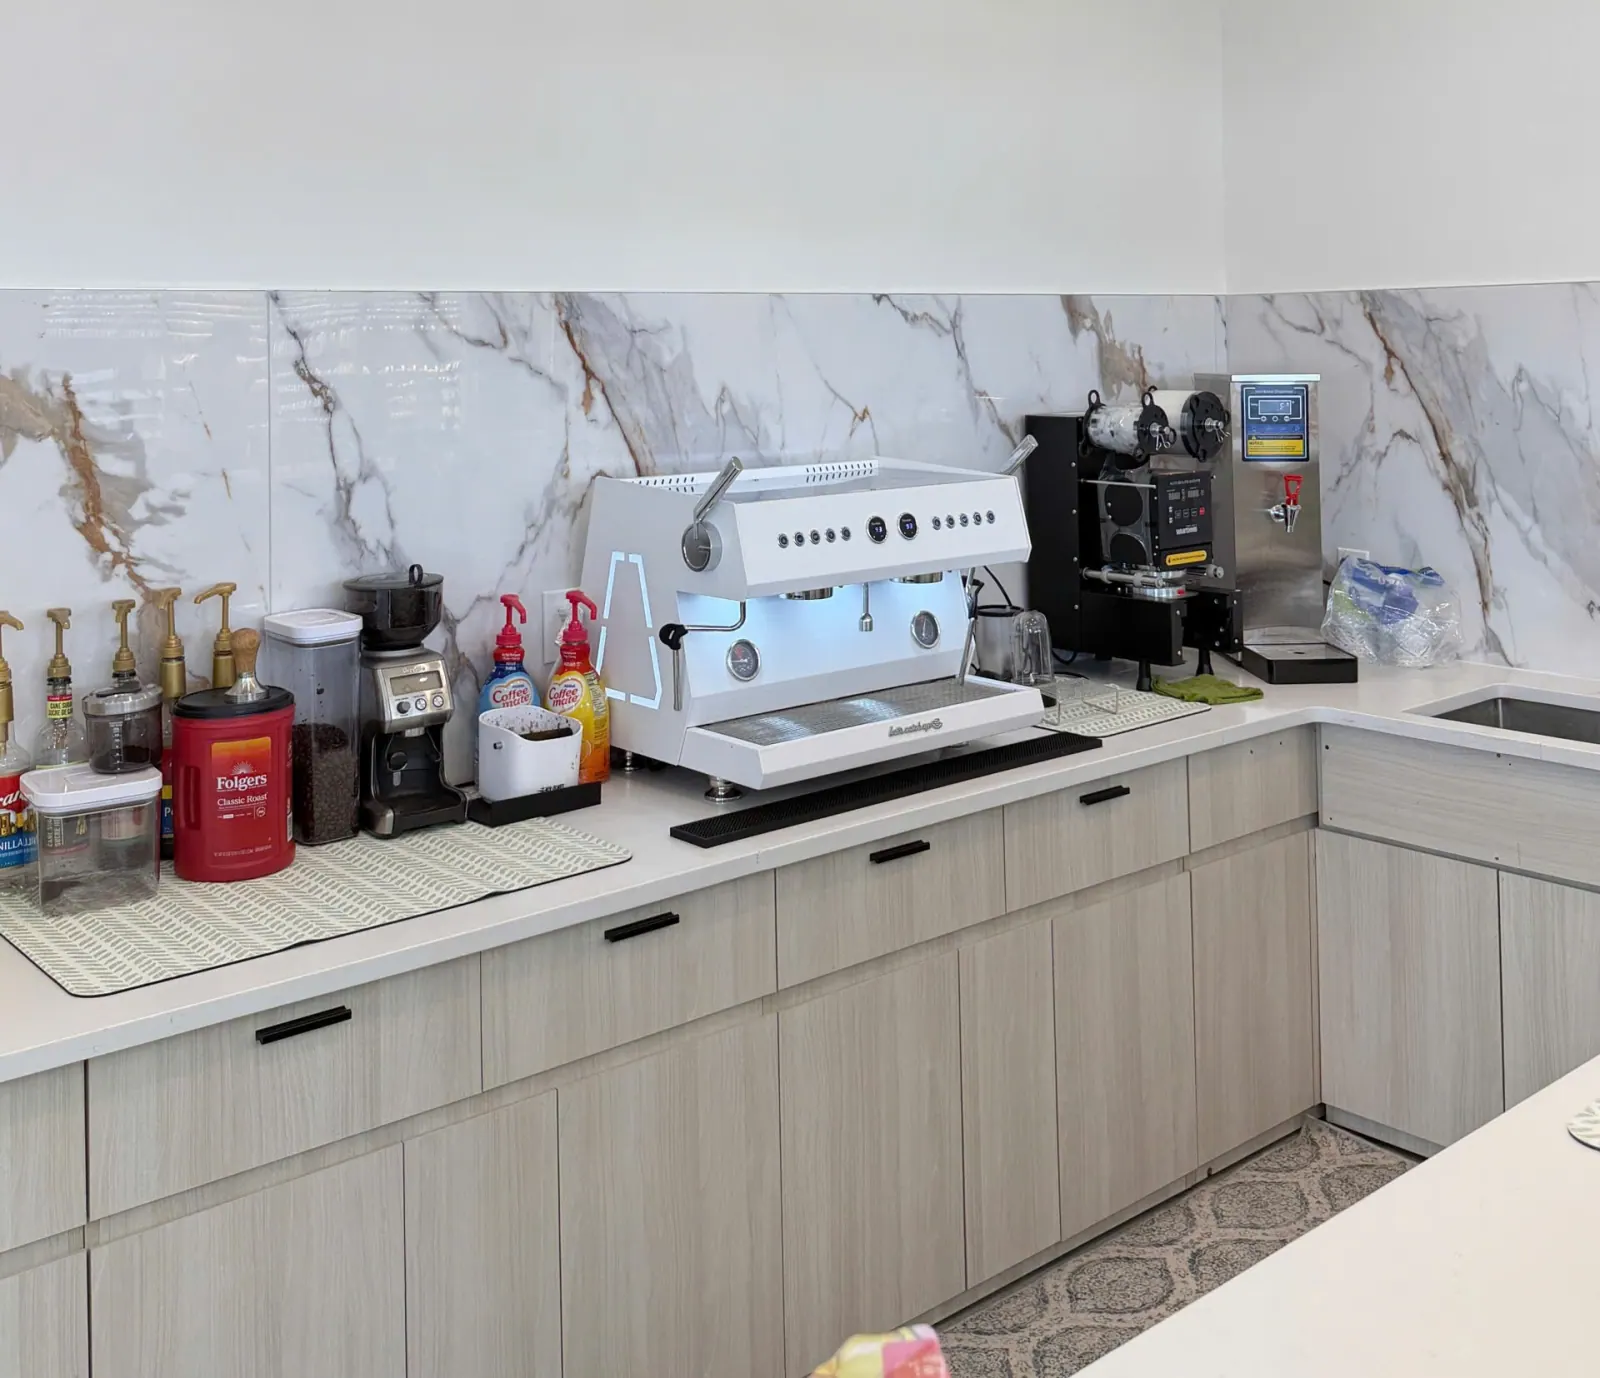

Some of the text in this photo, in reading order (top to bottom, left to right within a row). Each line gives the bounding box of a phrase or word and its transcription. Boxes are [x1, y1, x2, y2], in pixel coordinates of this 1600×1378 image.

[492, 687, 528, 704] Coffee
[502, 693, 530, 708] mate
[549, 687, 579, 700] Coffee
[552, 695, 579, 707] mate
[216, 774, 267, 792] Folgers
[217, 796, 245, 807] Classic
[246, 793, 268, 803] Roast
